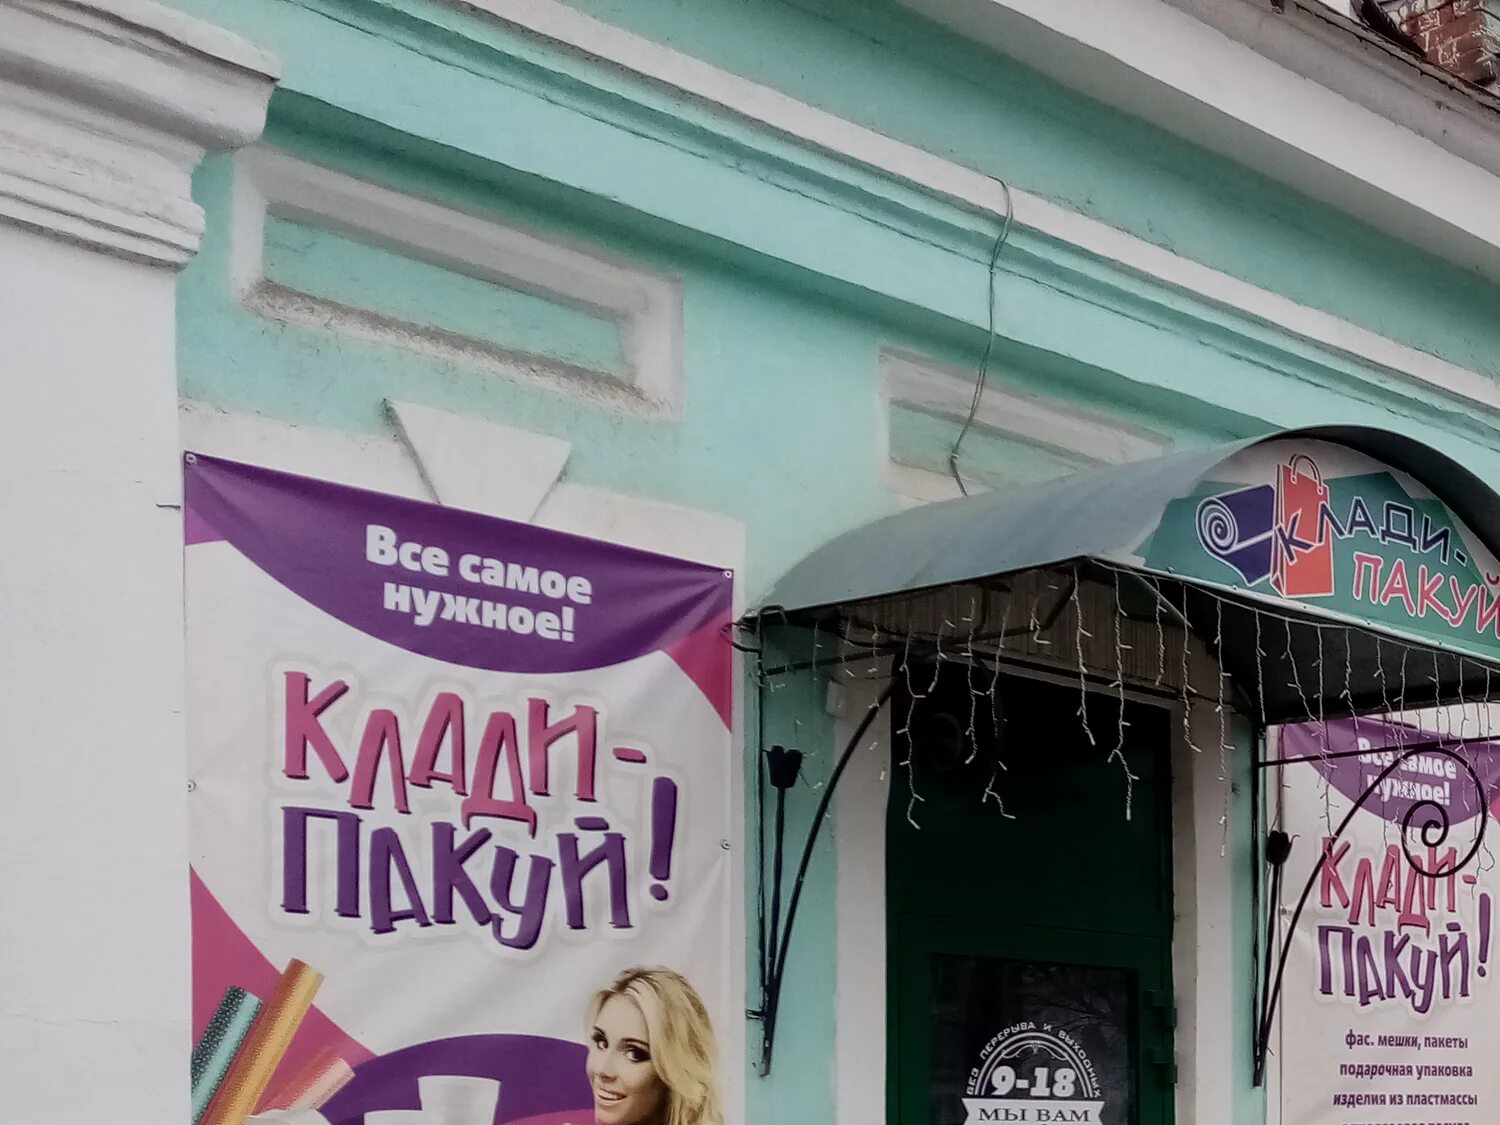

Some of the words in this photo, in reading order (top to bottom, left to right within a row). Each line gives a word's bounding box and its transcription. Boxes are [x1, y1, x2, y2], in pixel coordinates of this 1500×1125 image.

[366, 524, 448, 577] Все
[458, 552, 592, 604] самое
[383, 582, 575, 643] нужное!
[281, 670, 648, 839] КЛАДИ-
[1344, 1029, 1375, 1050] фас.
[1378, 1031, 1422, 1051] мешки,
[1424, 1035, 1468, 1049] пакеты
[980, 1021, 1037, 1060] ПЕРЕРЫВА
[1043, 1023, 1053, 1032] И
[1058, 1030, 1102, 1098] ВЫХОДНЫХ
[1339, 1062, 1413, 1080] подарочная
[1416, 1064, 1473, 1080] упаковка
[991, 1065, 1077, 1097] 9-18
[978, 1108, 1028, 1122] МЫ
[1035, 1109, 1091, 1122] ВАМ
[1333, 1093, 1386, 1108] изделия
[1389, 1093, 1404, 1106] из
[1406, 1093, 1478, 1106] пластмассы
